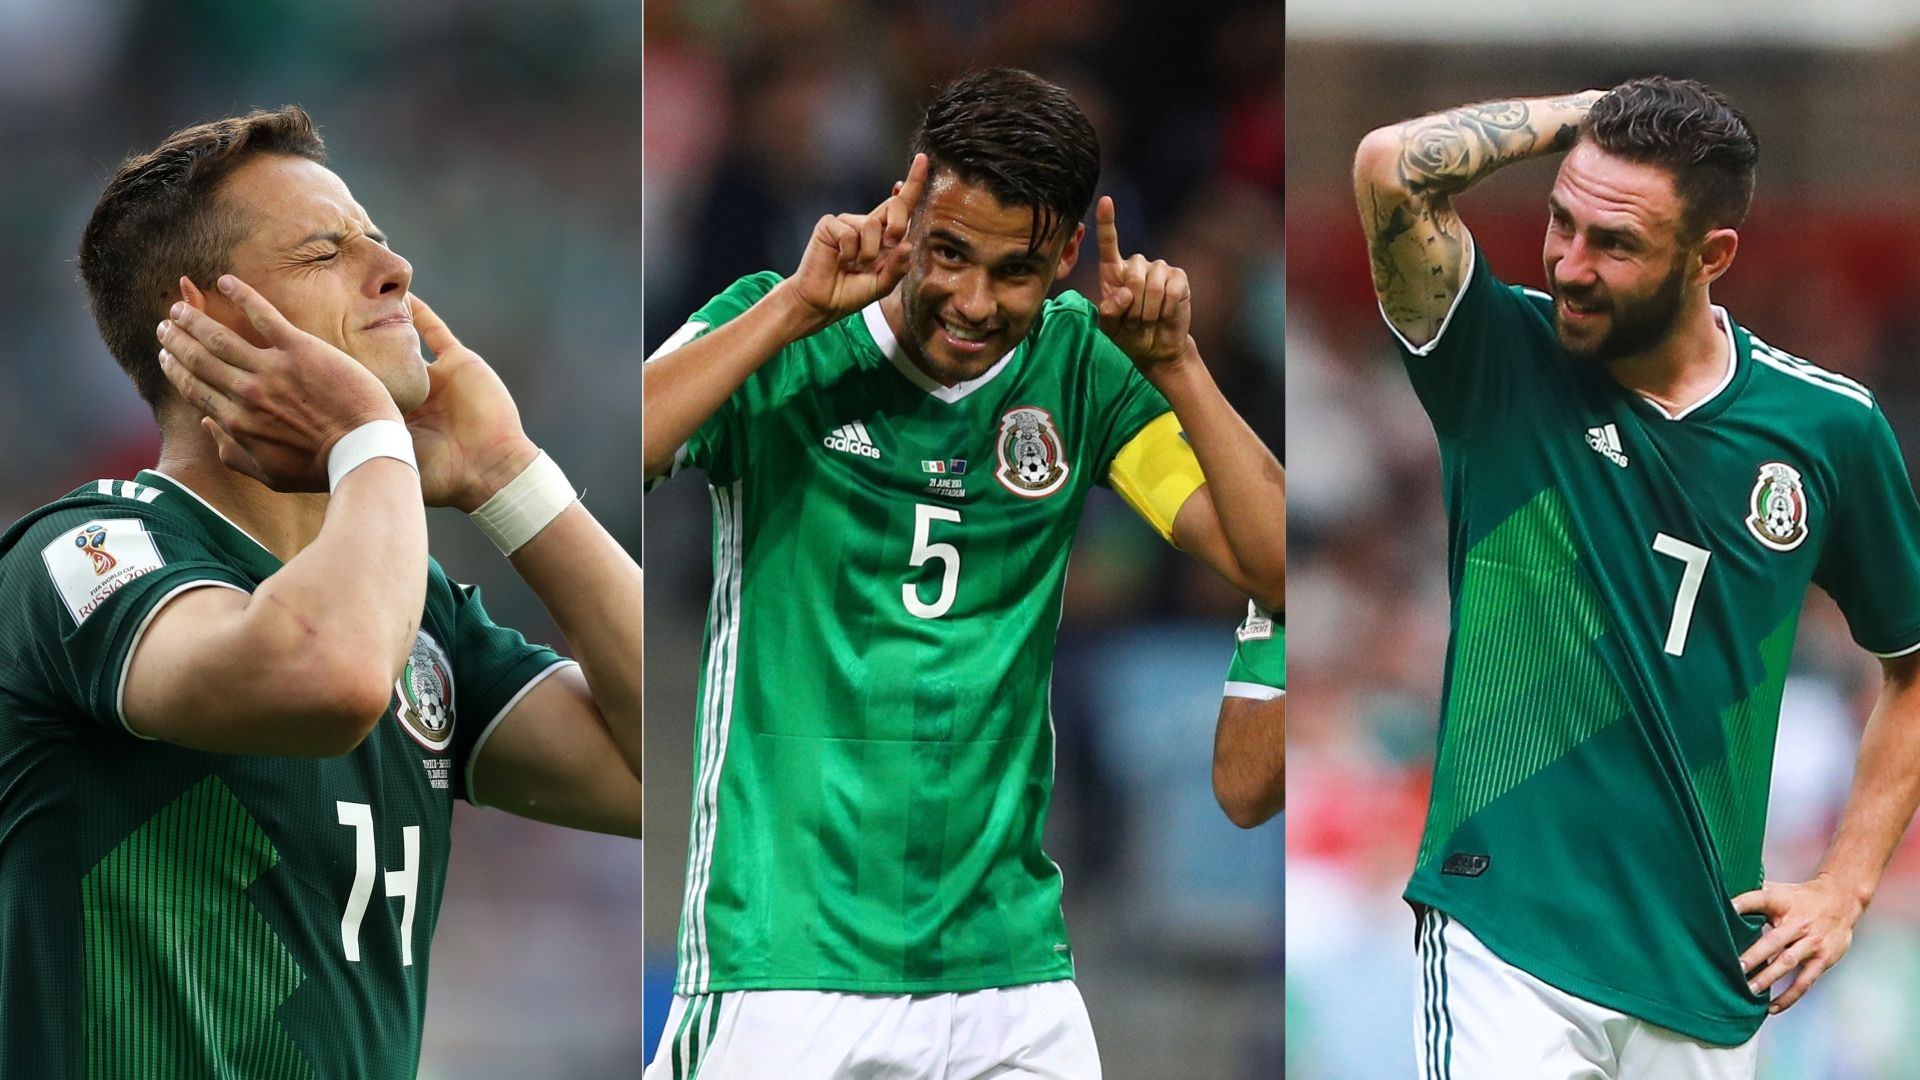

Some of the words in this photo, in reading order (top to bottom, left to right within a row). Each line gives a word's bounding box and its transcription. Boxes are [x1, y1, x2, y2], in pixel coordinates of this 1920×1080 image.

[823, 434, 881, 460] adidas
[1585, 433, 1629, 468] adidas
[939, 488, 966, 497] STADIUM
[902, 503, 962, 619] 5
[78, 578, 125, 618] RUSSIA
[90, 584, 103, 596] FIFA
[101, 571, 122, 587] WORLD
[122, 565, 136, 575] CUP
[1652, 532, 1711, 657] 7
